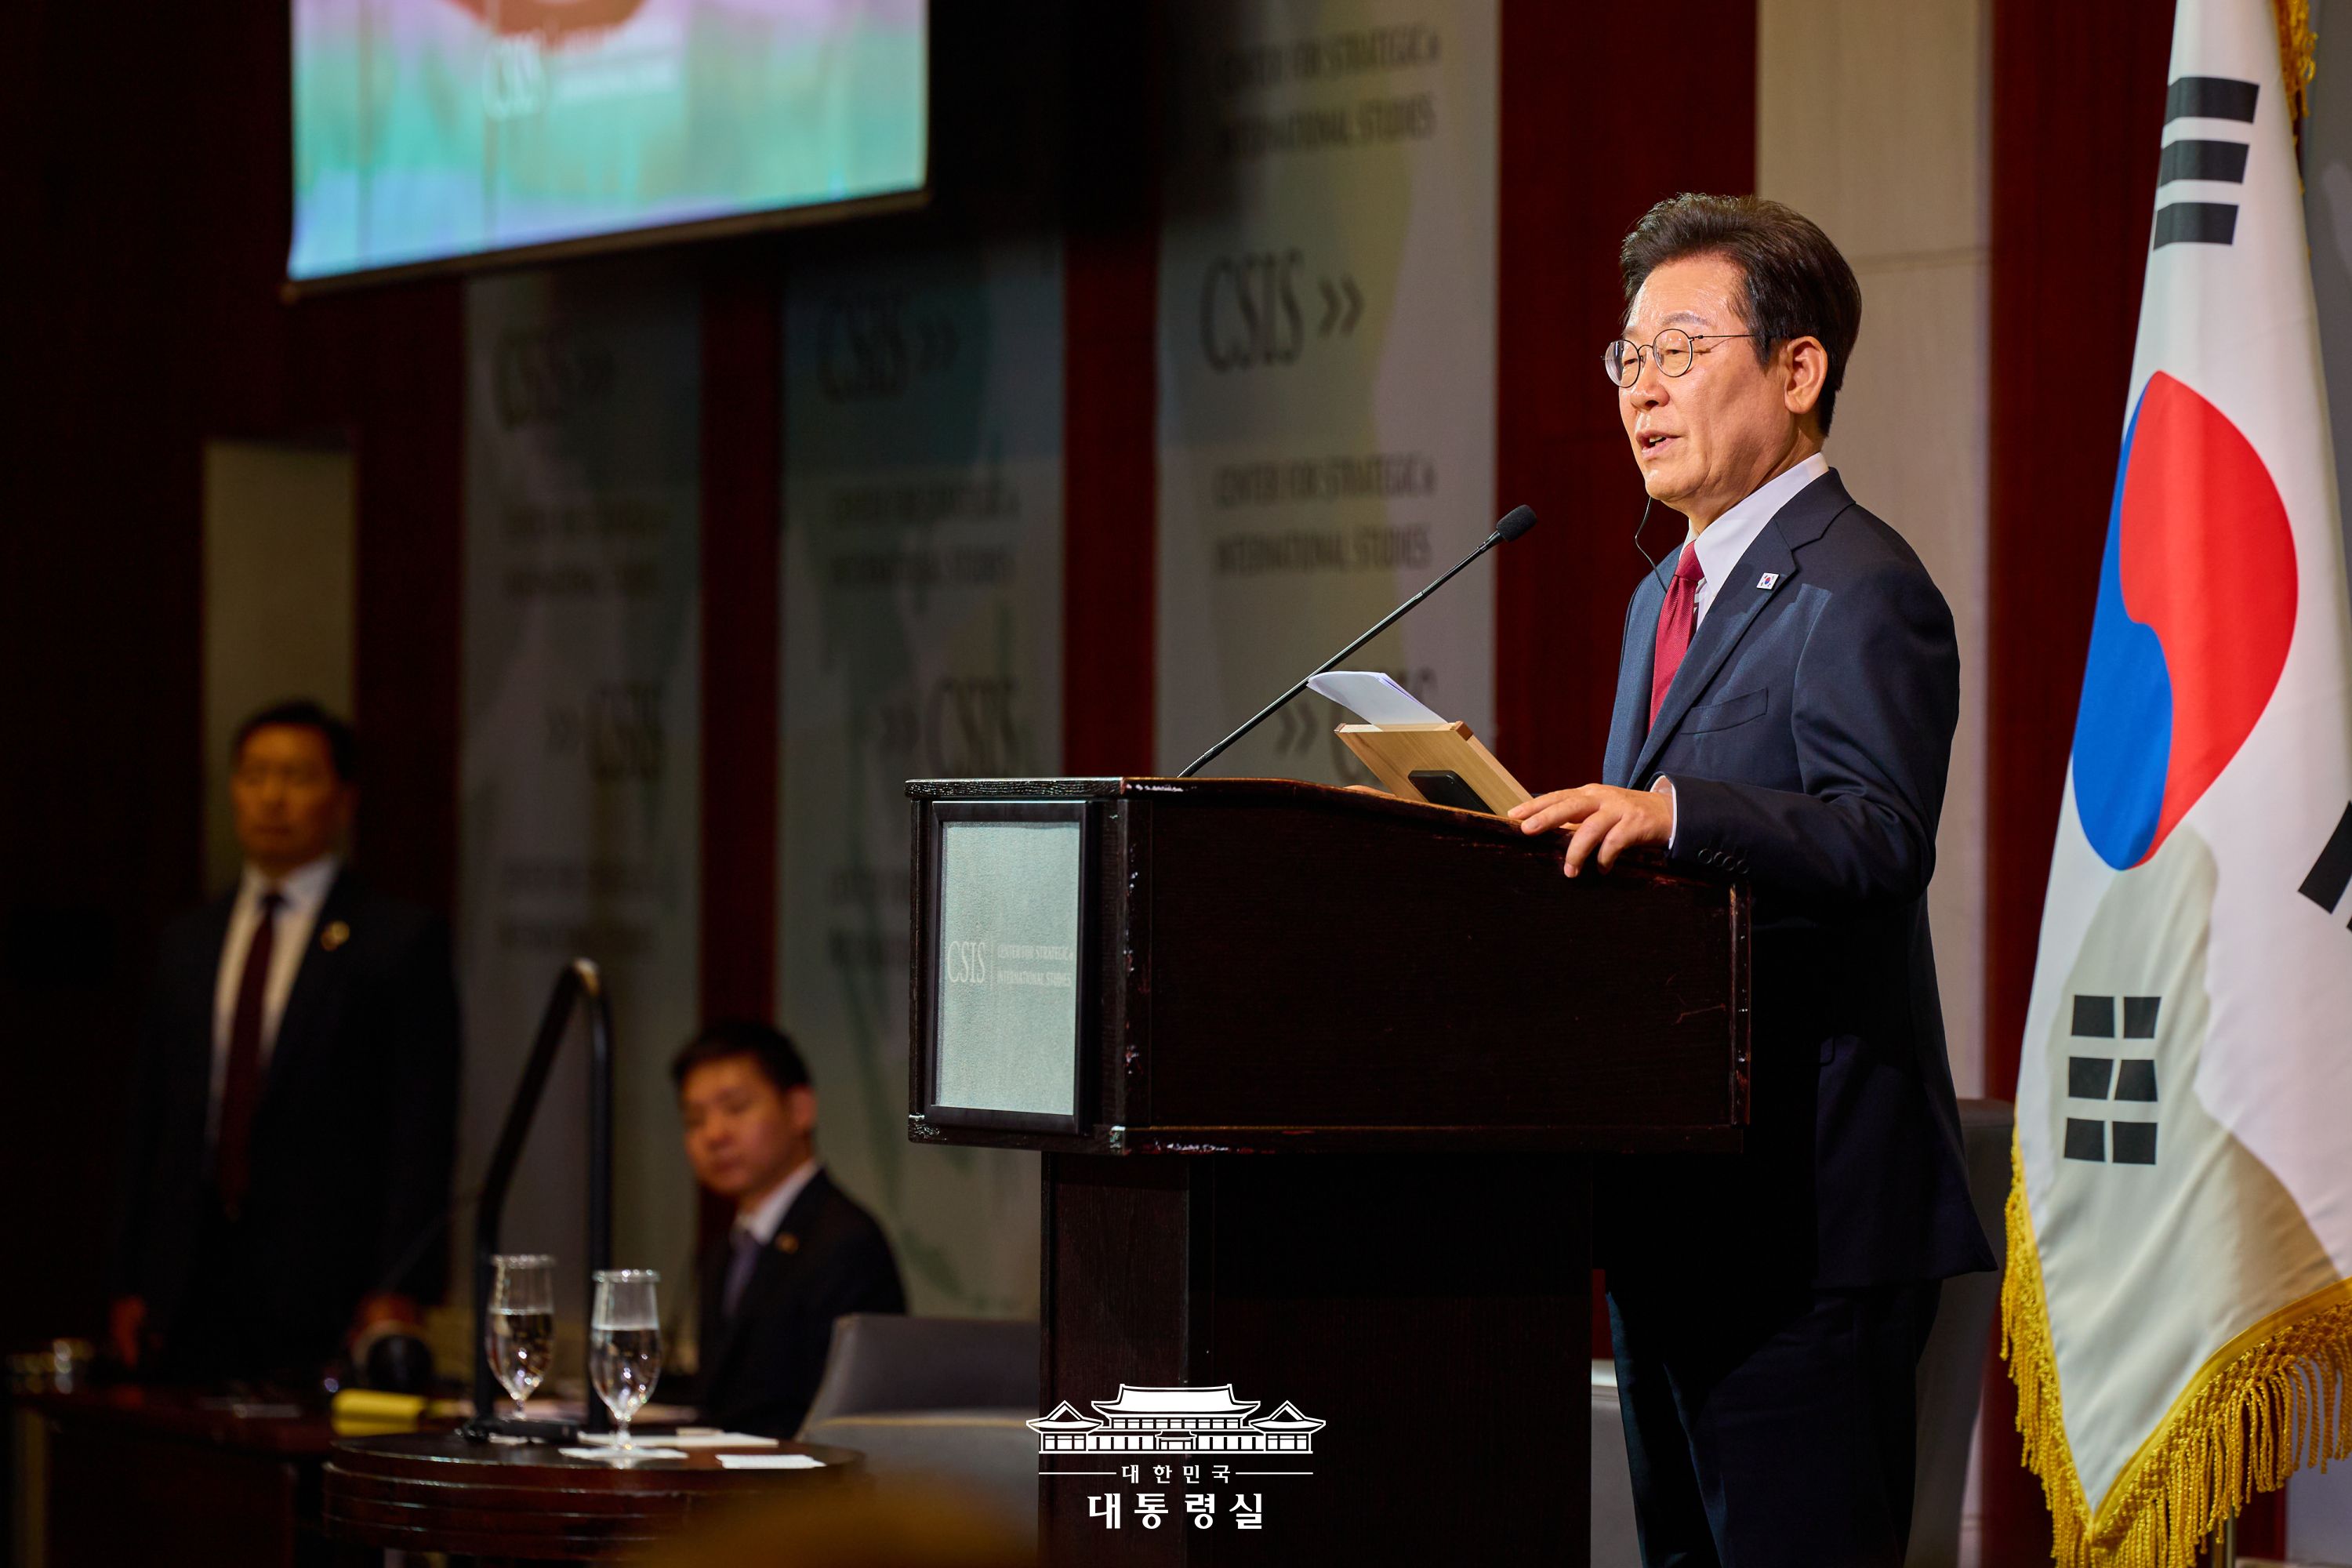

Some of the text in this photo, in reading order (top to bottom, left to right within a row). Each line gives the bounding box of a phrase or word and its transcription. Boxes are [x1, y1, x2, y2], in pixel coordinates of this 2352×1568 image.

[1200, 246, 1305, 373] CSIS
[947, 941, 985, 984] CSIS
[1036, 946, 1068, 960] STRATEGIC
[997, 971, 1072, 988] INTERNATIONAL STUDIES
